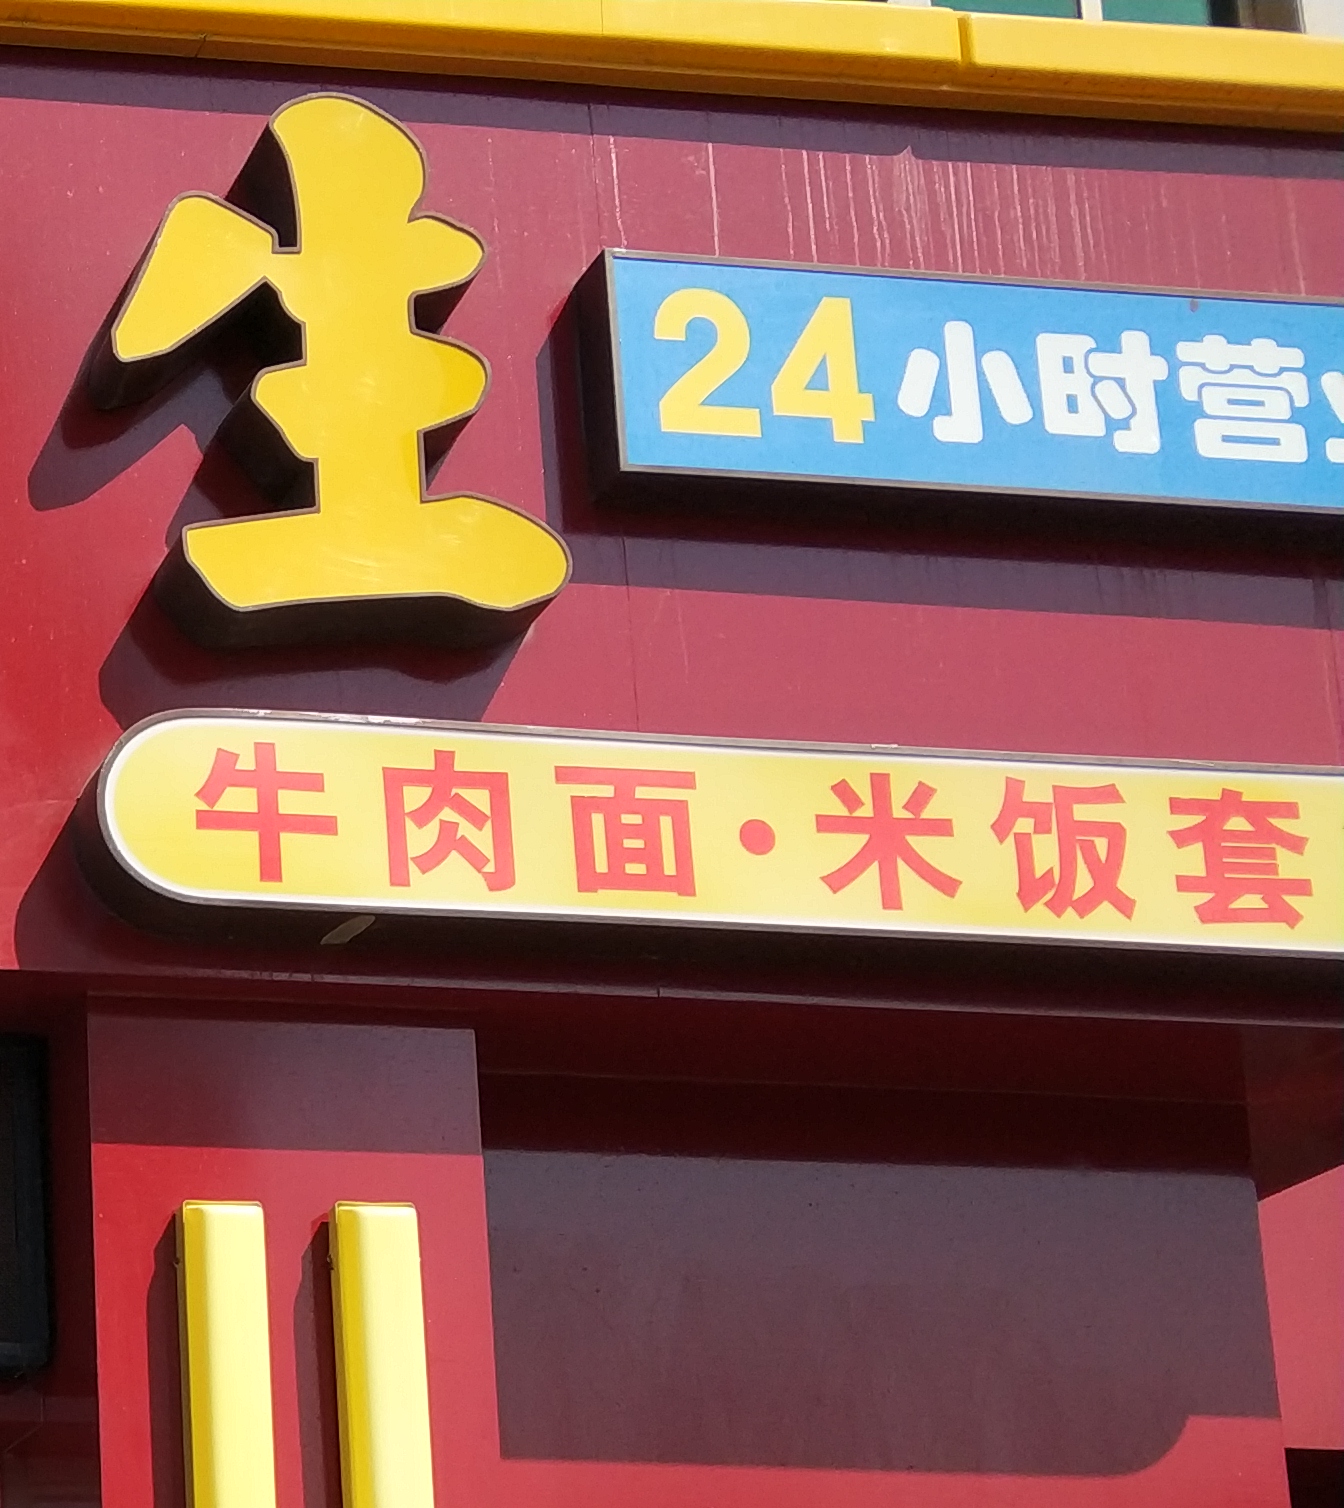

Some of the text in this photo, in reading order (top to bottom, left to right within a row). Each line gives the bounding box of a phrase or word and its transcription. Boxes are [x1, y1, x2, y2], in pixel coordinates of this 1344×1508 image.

[654, 288, 1344, 464] 24小时营
[195, 742, 1313, 929] 牛肉面·米饭套
